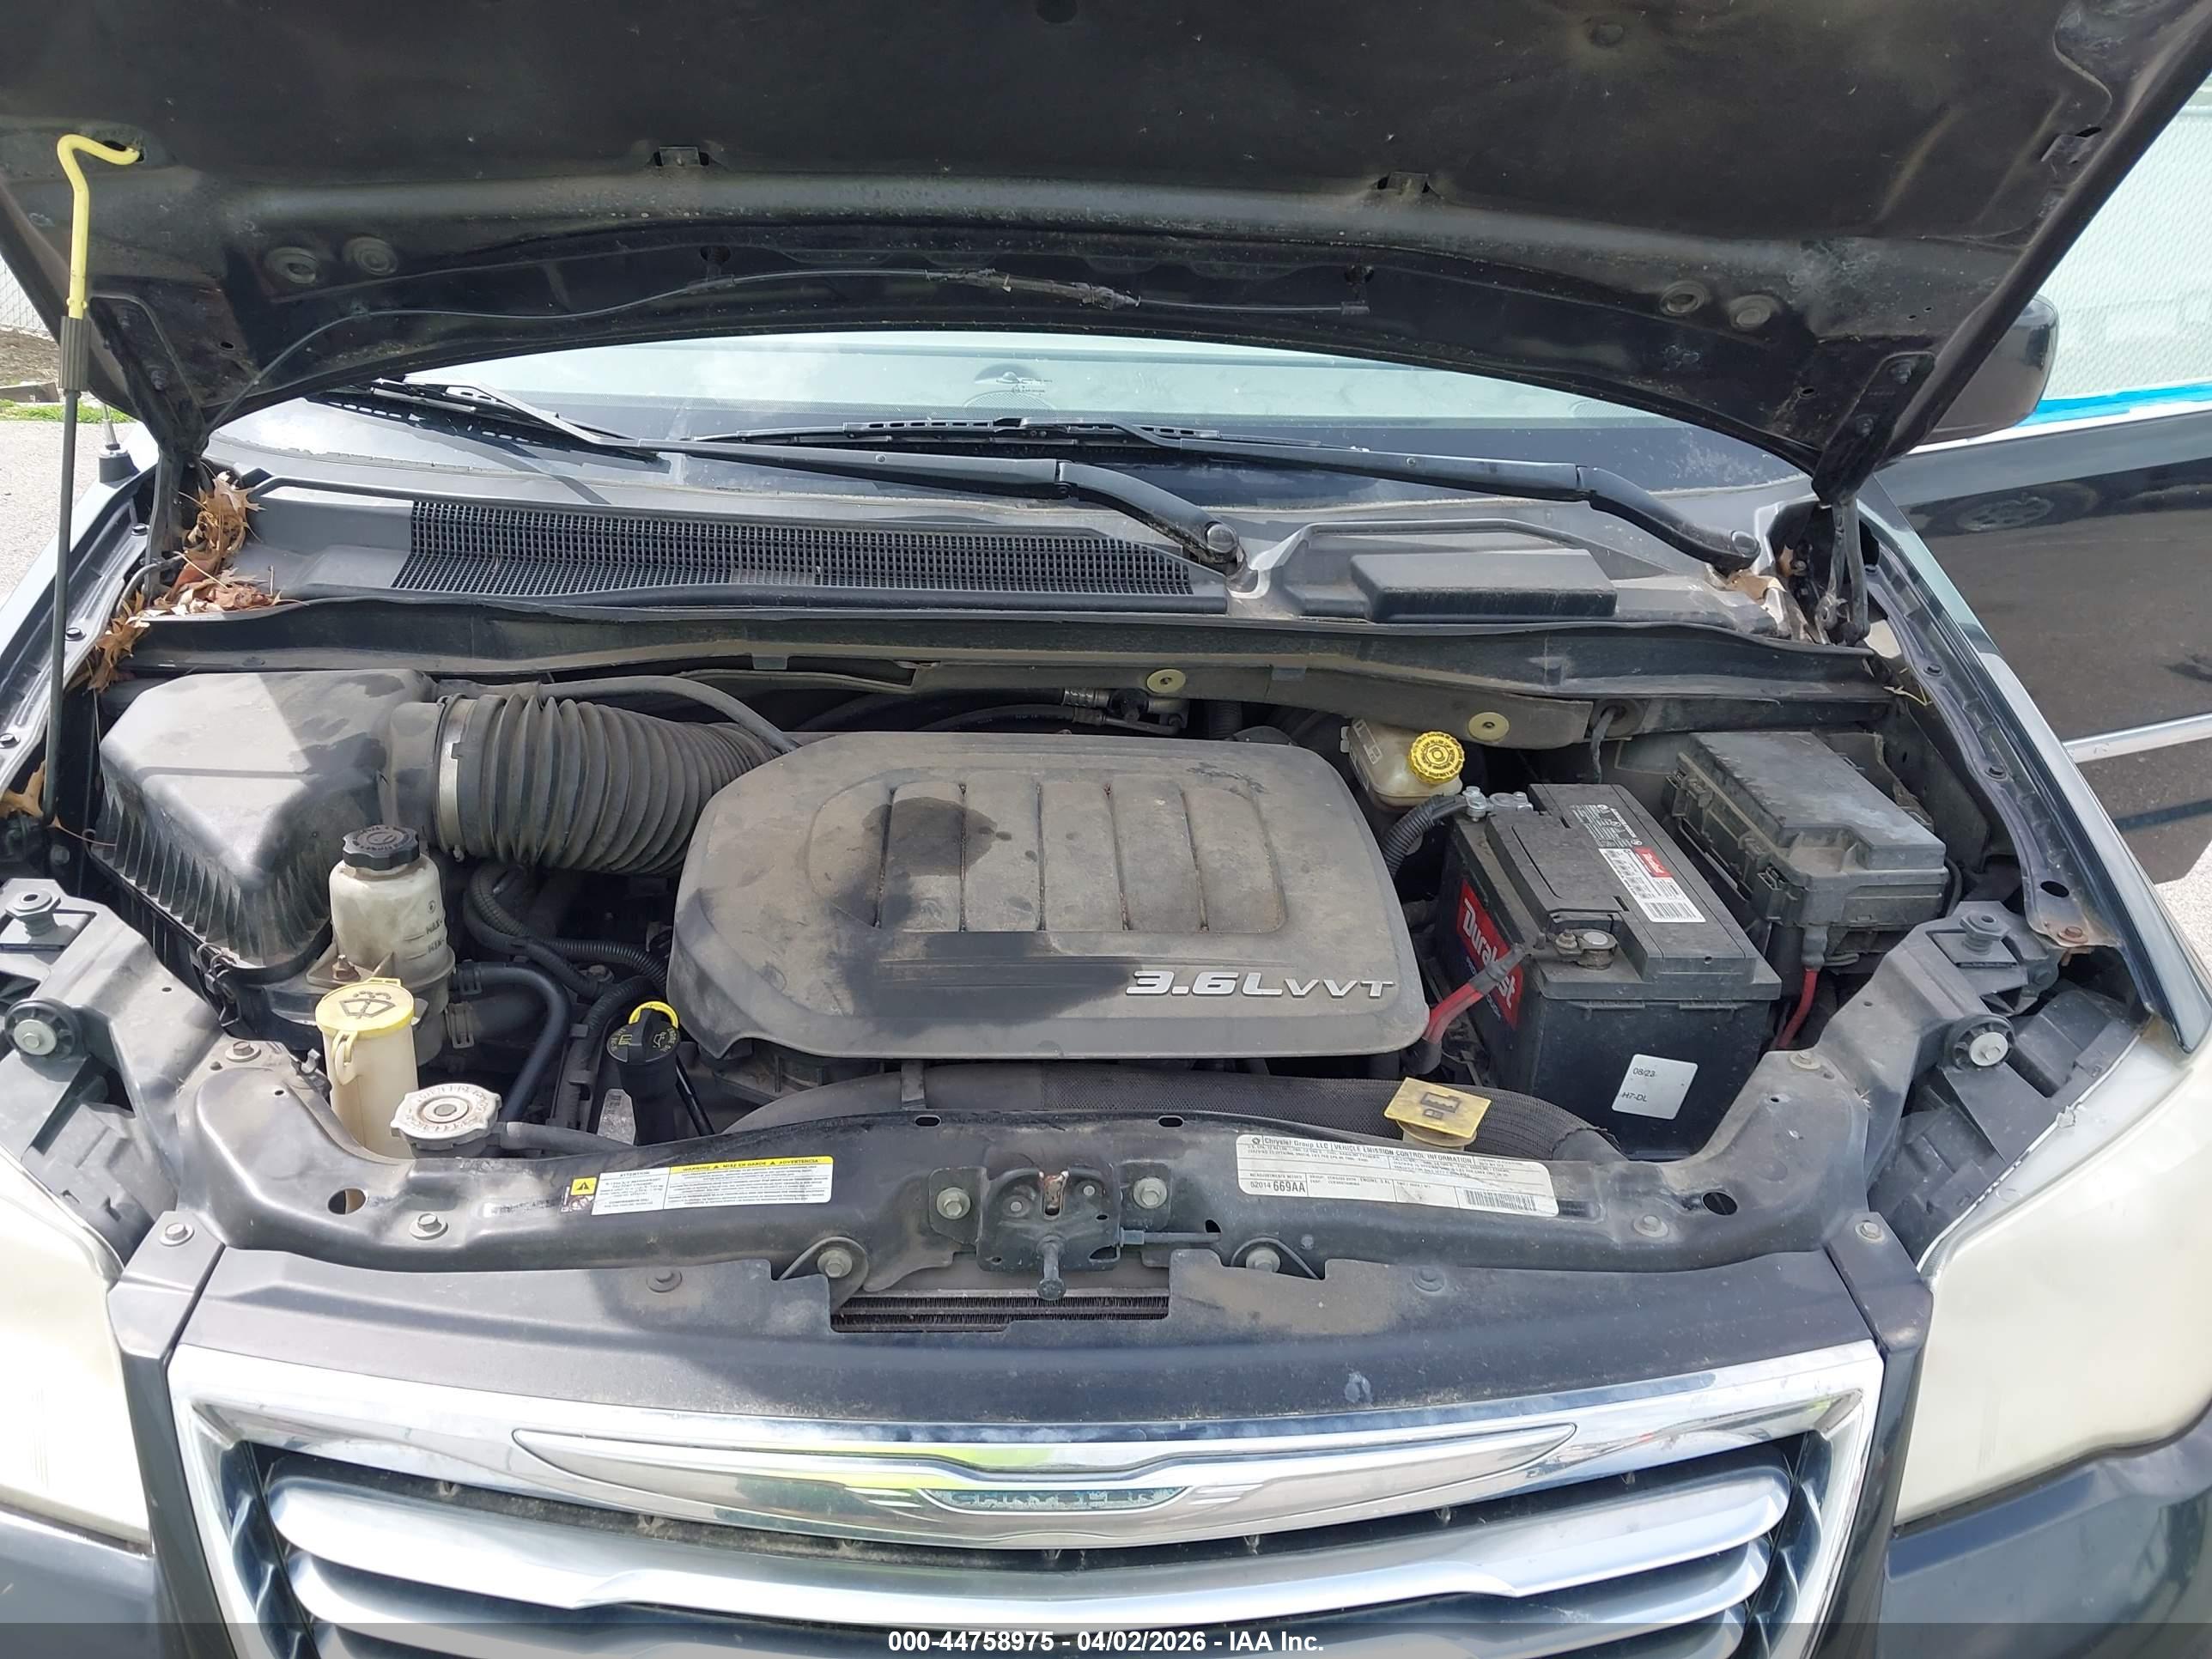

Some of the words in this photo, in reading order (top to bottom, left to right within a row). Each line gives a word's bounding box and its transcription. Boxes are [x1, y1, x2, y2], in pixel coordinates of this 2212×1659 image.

[1632, 1067, 1656, 1078] 08/23
[1264, 1138, 1291, 1146] Chrysler
[1294, 1139, 1314, 1149] Group
[1363, 1146, 1394, 1155] EMISSION
[1395, 1150, 1425, 1158] CONTROL
[1427, 1153, 1472, 1164] INFORMATION
[1273, 1181, 1306, 1193] 669AA
